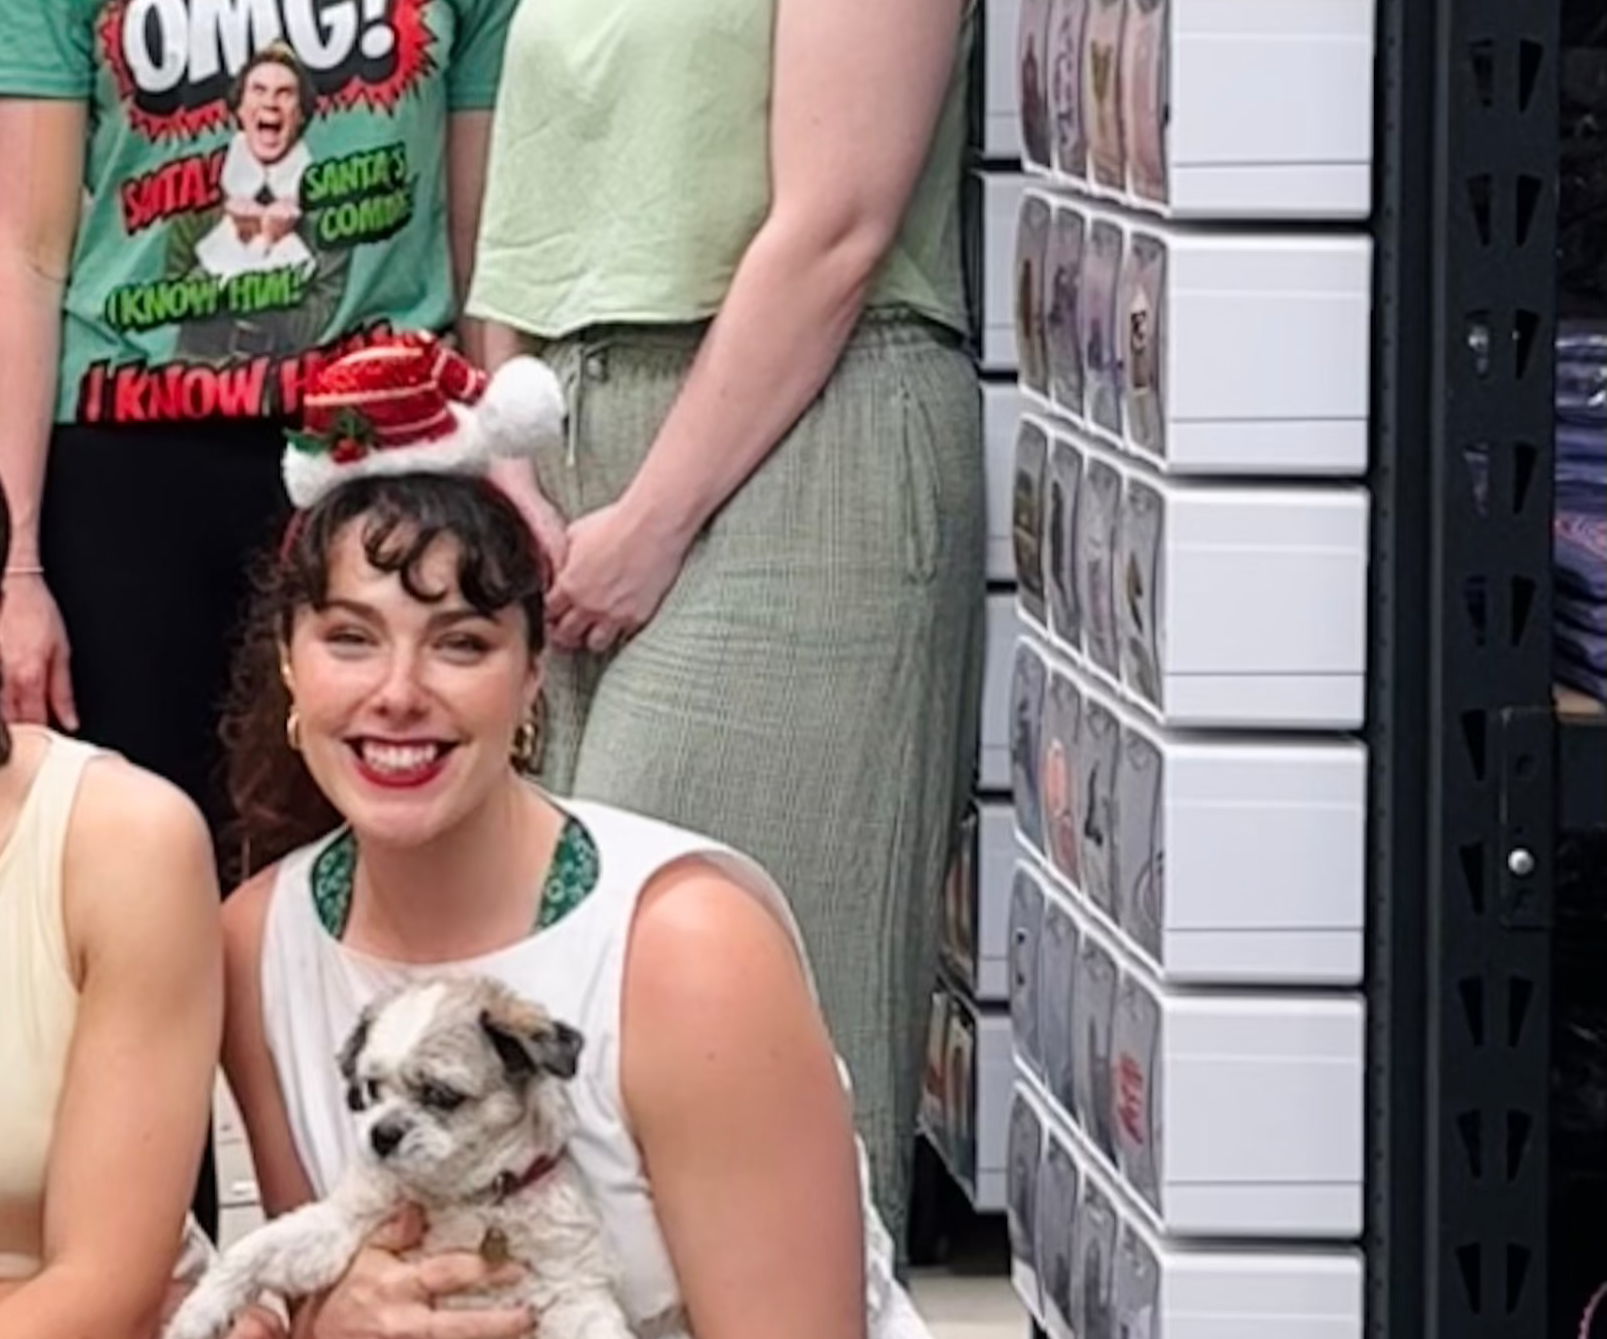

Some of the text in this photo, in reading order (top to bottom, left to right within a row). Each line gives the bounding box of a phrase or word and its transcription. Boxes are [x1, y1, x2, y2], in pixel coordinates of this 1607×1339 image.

[107, 293, 117, 325] I
[120, 281, 218, 325] KNOW
[86, 365, 105, 422] I
[114, 356, 270, 422] KNOW
